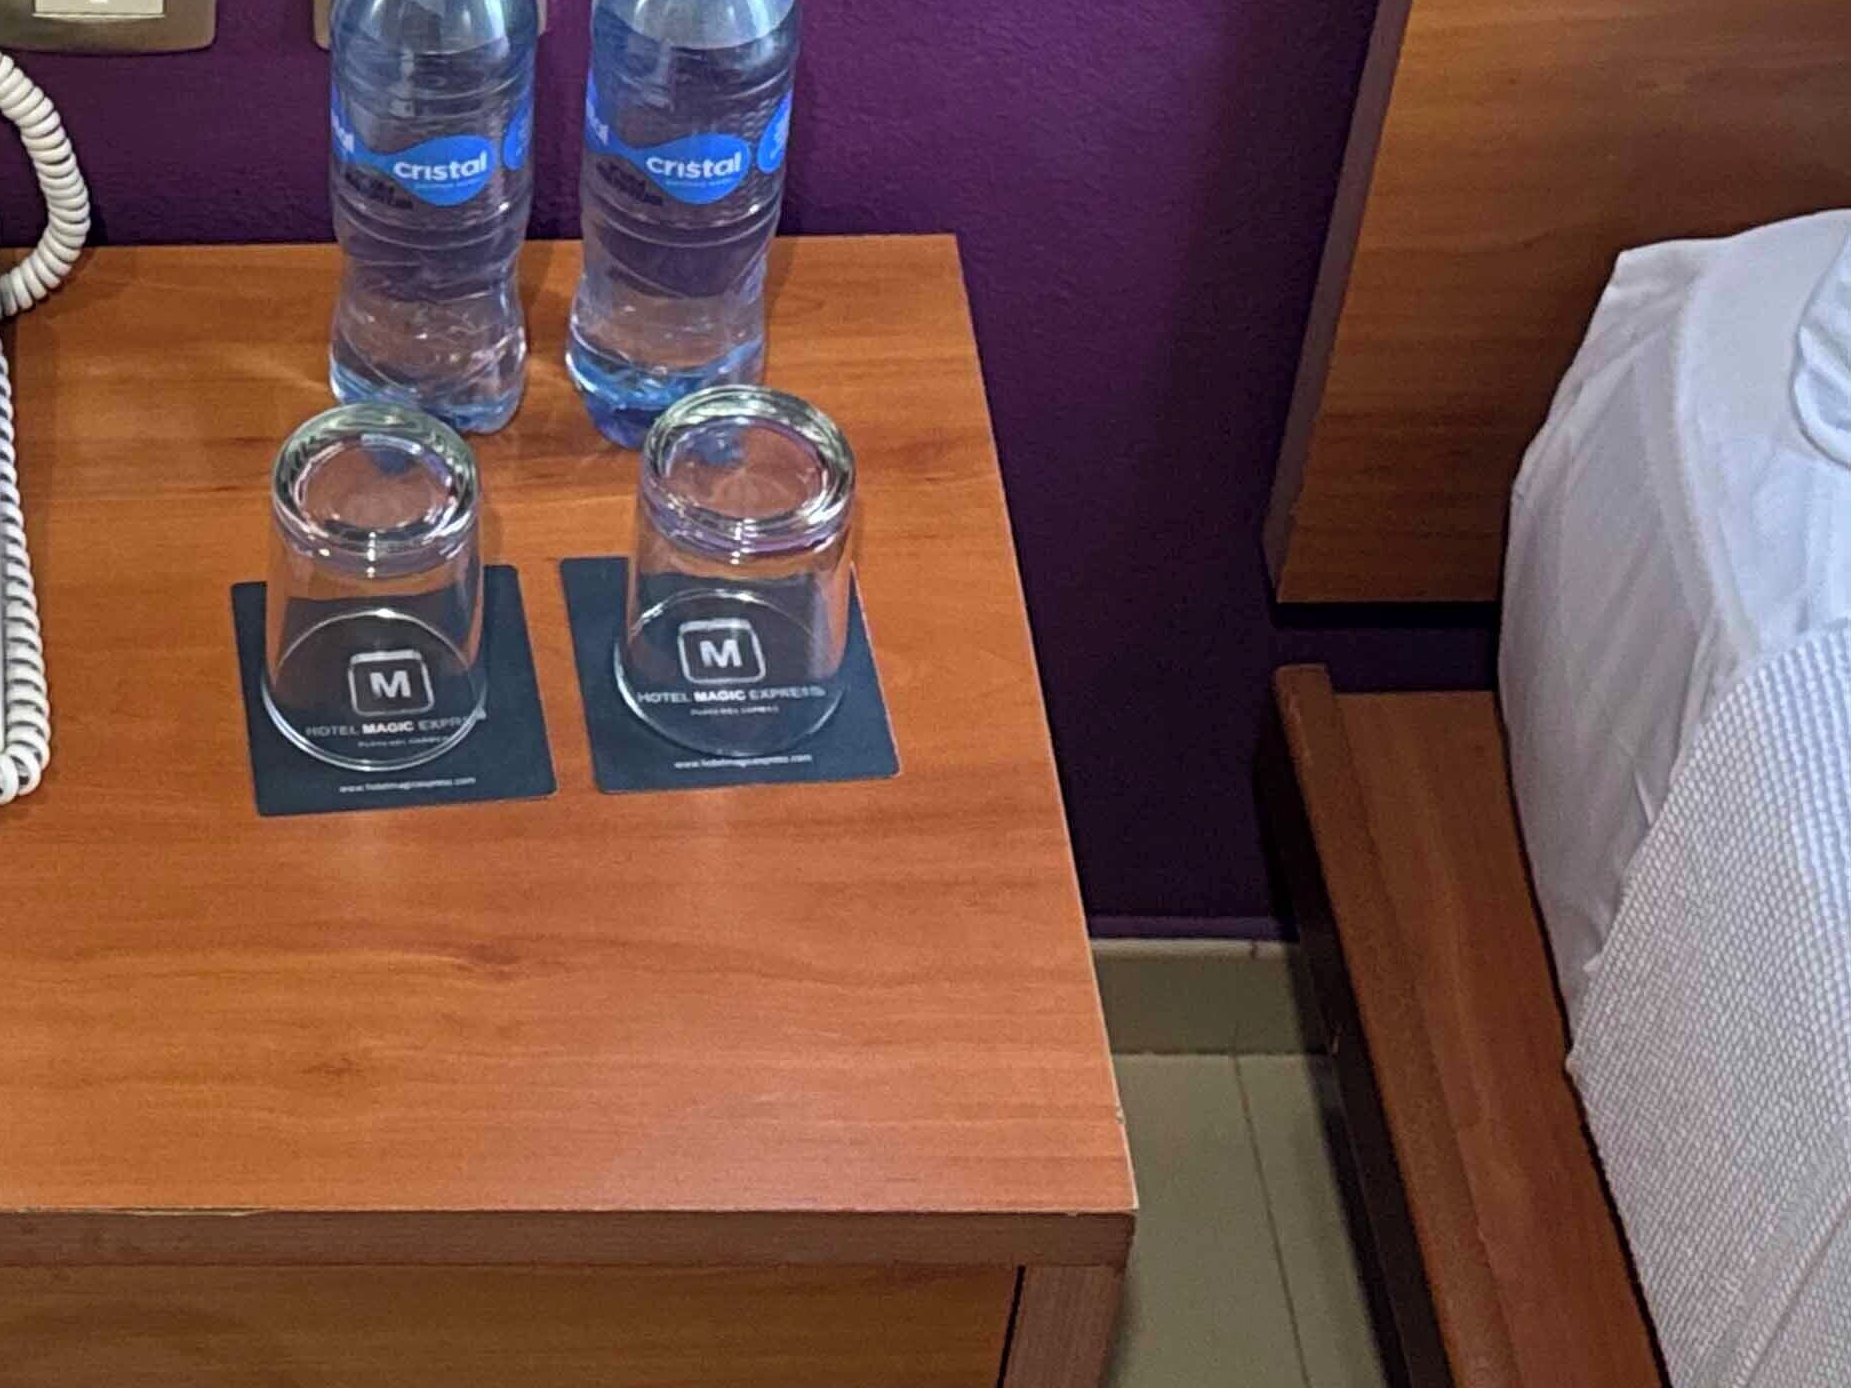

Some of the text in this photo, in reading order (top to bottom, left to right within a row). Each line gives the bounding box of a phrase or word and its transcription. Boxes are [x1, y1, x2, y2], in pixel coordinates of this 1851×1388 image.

[392, 150, 488, 181] cristal
[646, 151, 742, 179] cristal
[700, 639, 743, 668] M
[370, 670, 412, 698] M
[636, 691, 692, 704] HOTEL
[693, 689, 746, 702] MAGIC
[305, 723, 359, 737] HOTEL
[362, 720, 414, 734] MAGIC
